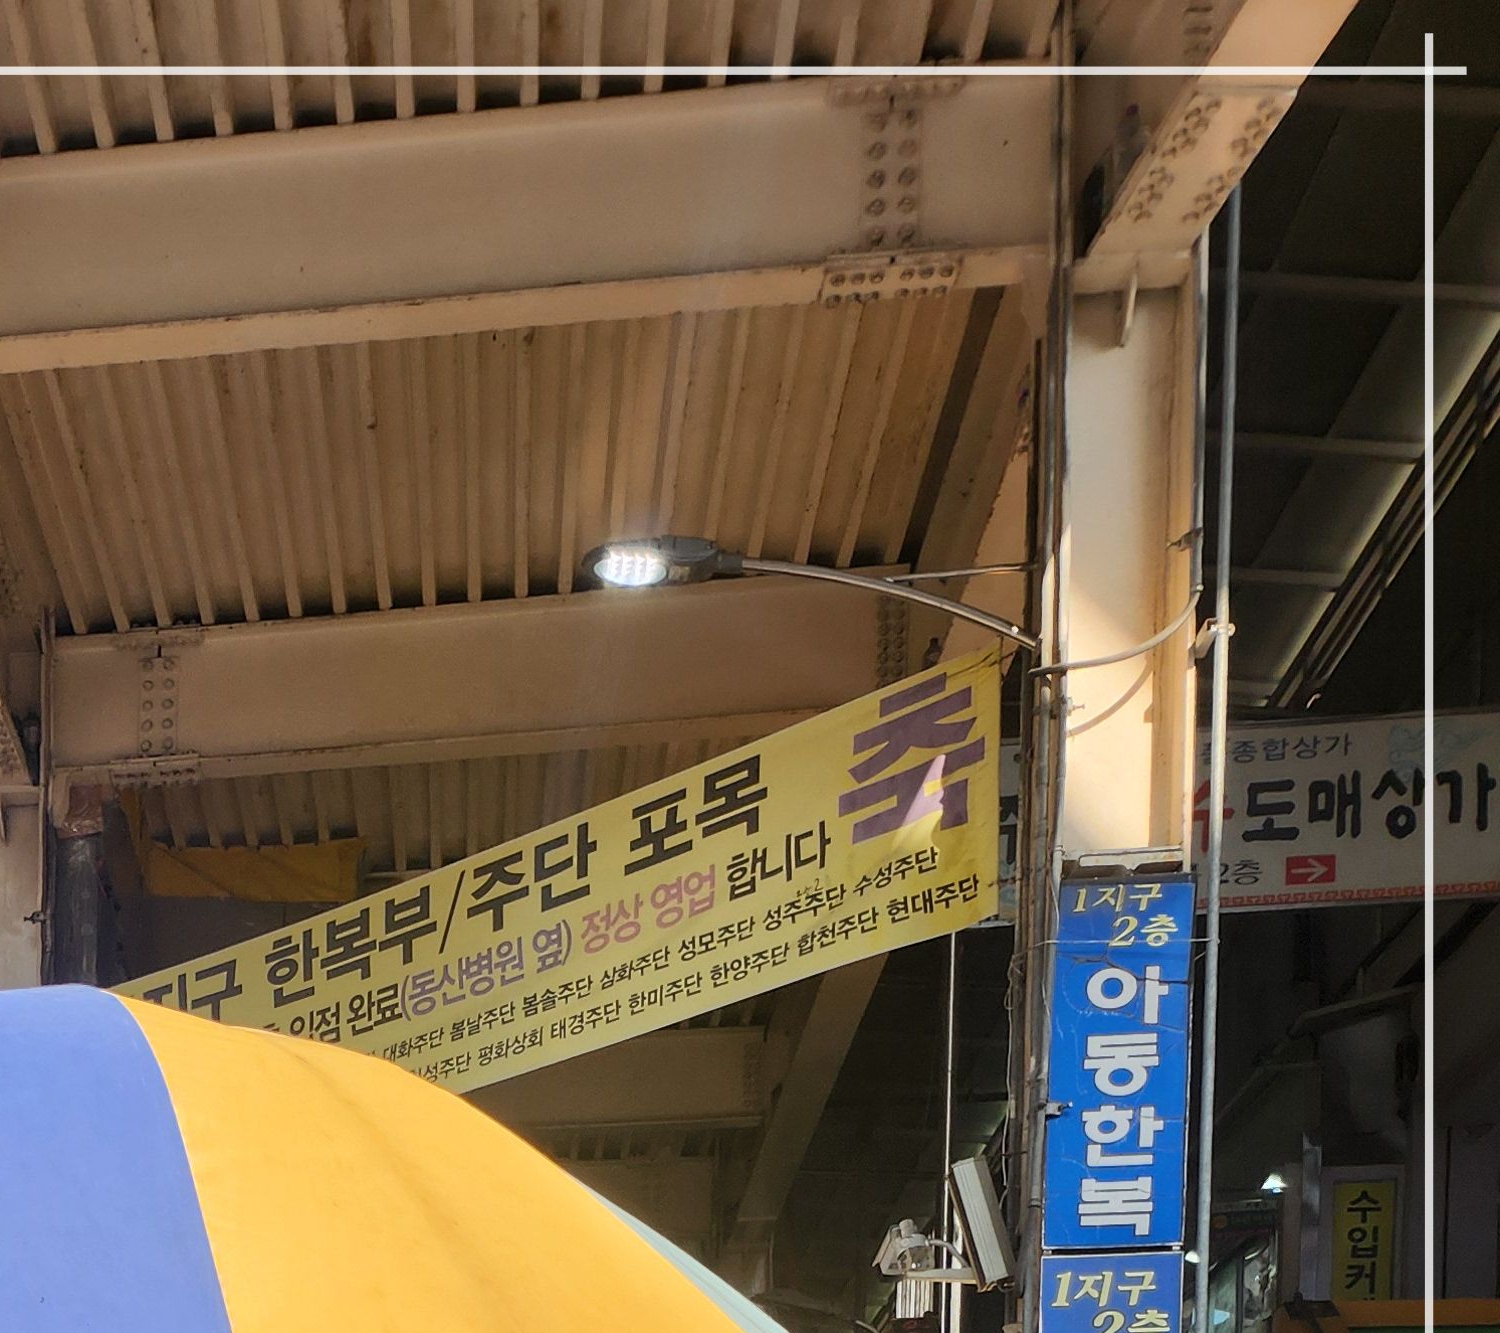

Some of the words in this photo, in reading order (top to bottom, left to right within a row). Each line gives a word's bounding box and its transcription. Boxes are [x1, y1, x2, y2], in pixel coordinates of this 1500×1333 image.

[838, 673, 986, 842] 축
[265, 821, 601, 1009] 한복부/주단
[624, 753, 770, 875] 포목
[450, 1006, 516, 1042] 봄날주단
[600, 947, 671, 990] 삼화주단
[677, 916, 756, 961] 성모주단
[762, 885, 847, 931] 성주주단
[852, 846, 939, 897] 수성주단
[581, 893, 644, 955] 정상
[651, 864, 716, 929] 영업
[726, 820, 832, 901] 합니다
[1073, 881, 1163, 913] 1지구
[1108, 914, 1179, 949] 2층
[477, 1029, 543, 1067] 평화상회
[550, 1002, 621, 1039] 태경주단
[627, 971, 702, 1017] 한미주단
[709, 942, 790, 988] 한양주단
[797, 909, 879, 956] 합천주단
[886, 874, 980, 924] 현대주단
[1077, 965, 1170, 1236] 아동한복
[1051, 1271, 1156, 1308] 1지구
[1345, 1189, 1382, 1300] 수입커
